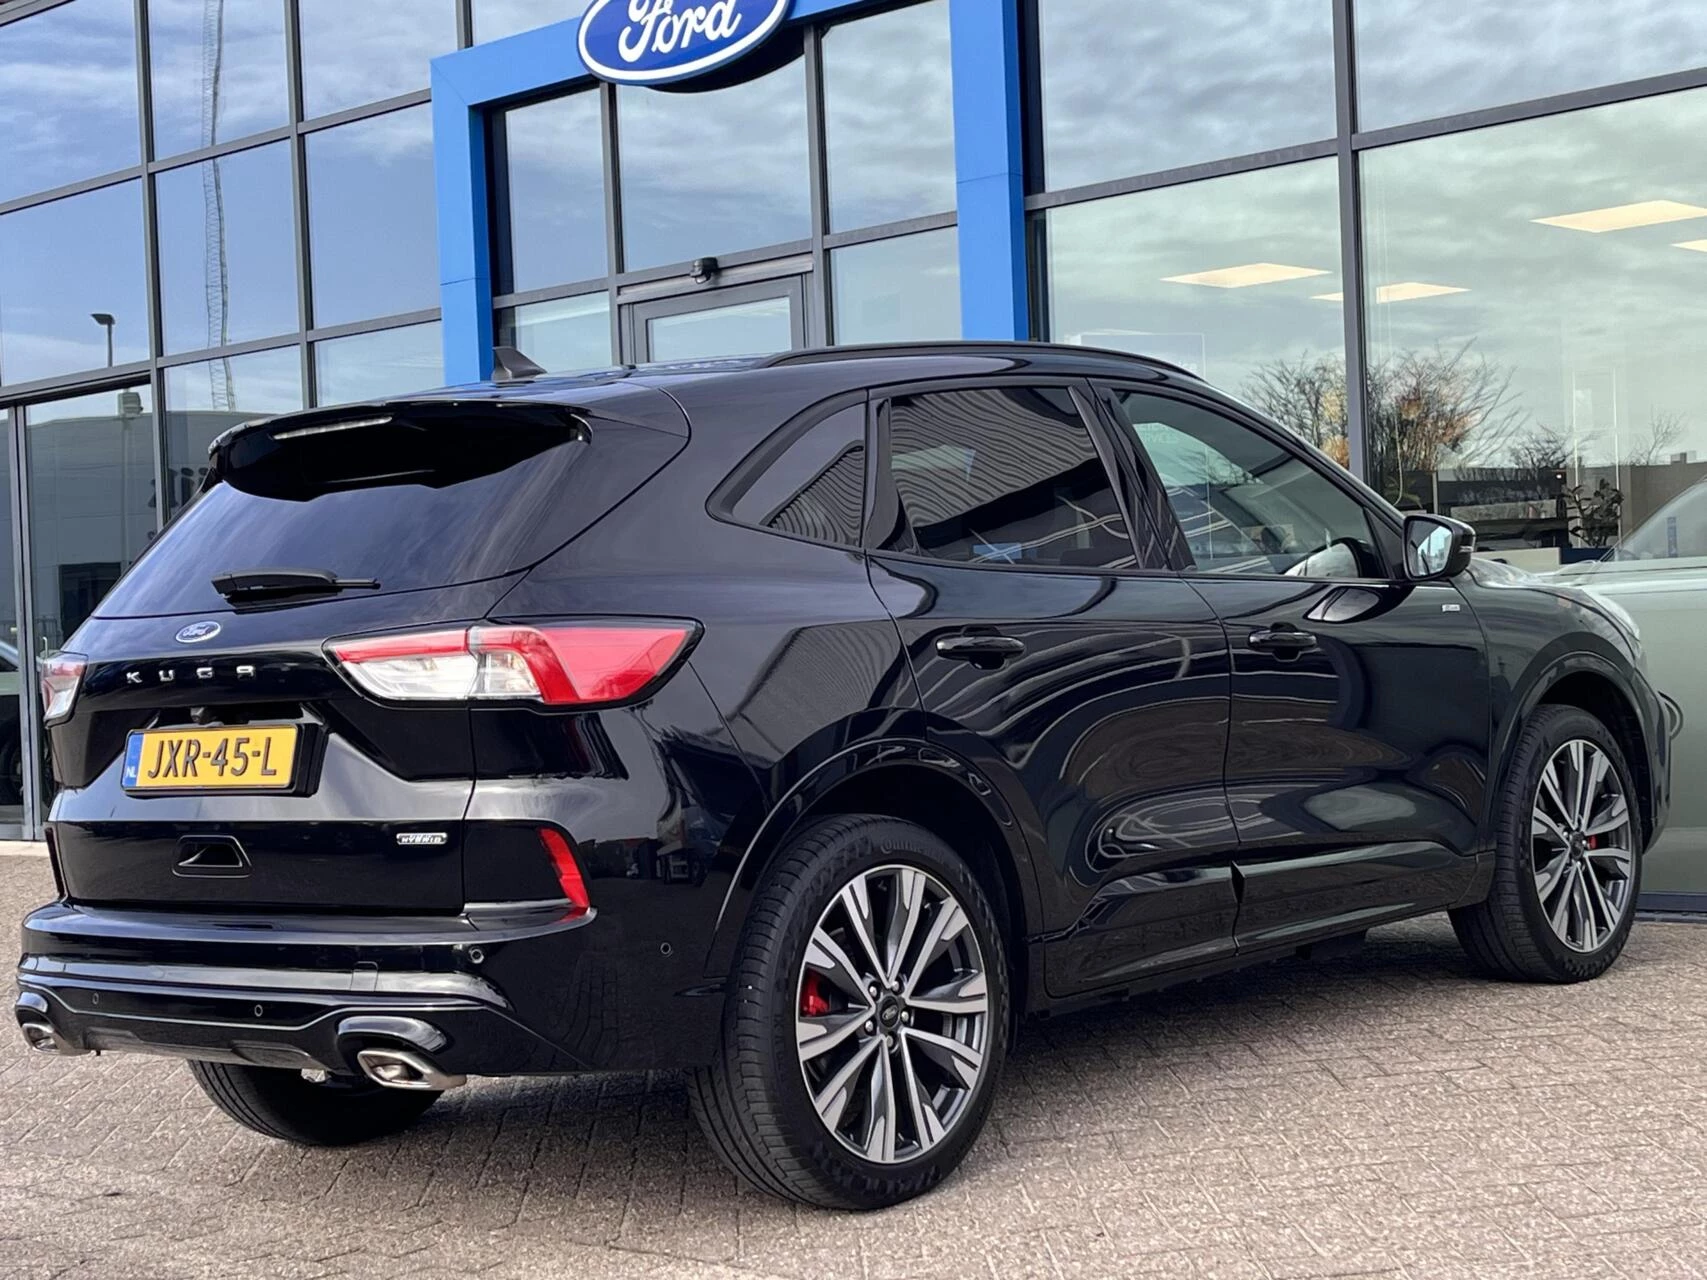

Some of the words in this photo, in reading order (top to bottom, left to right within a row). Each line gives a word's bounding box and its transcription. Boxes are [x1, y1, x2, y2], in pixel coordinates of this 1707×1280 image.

[618, 0, 741, 62] Ford
[126, 665, 256, 684] KUGA
[126, 767, 137, 778] NL
[147, 737, 277, 779] JXR-45-L
